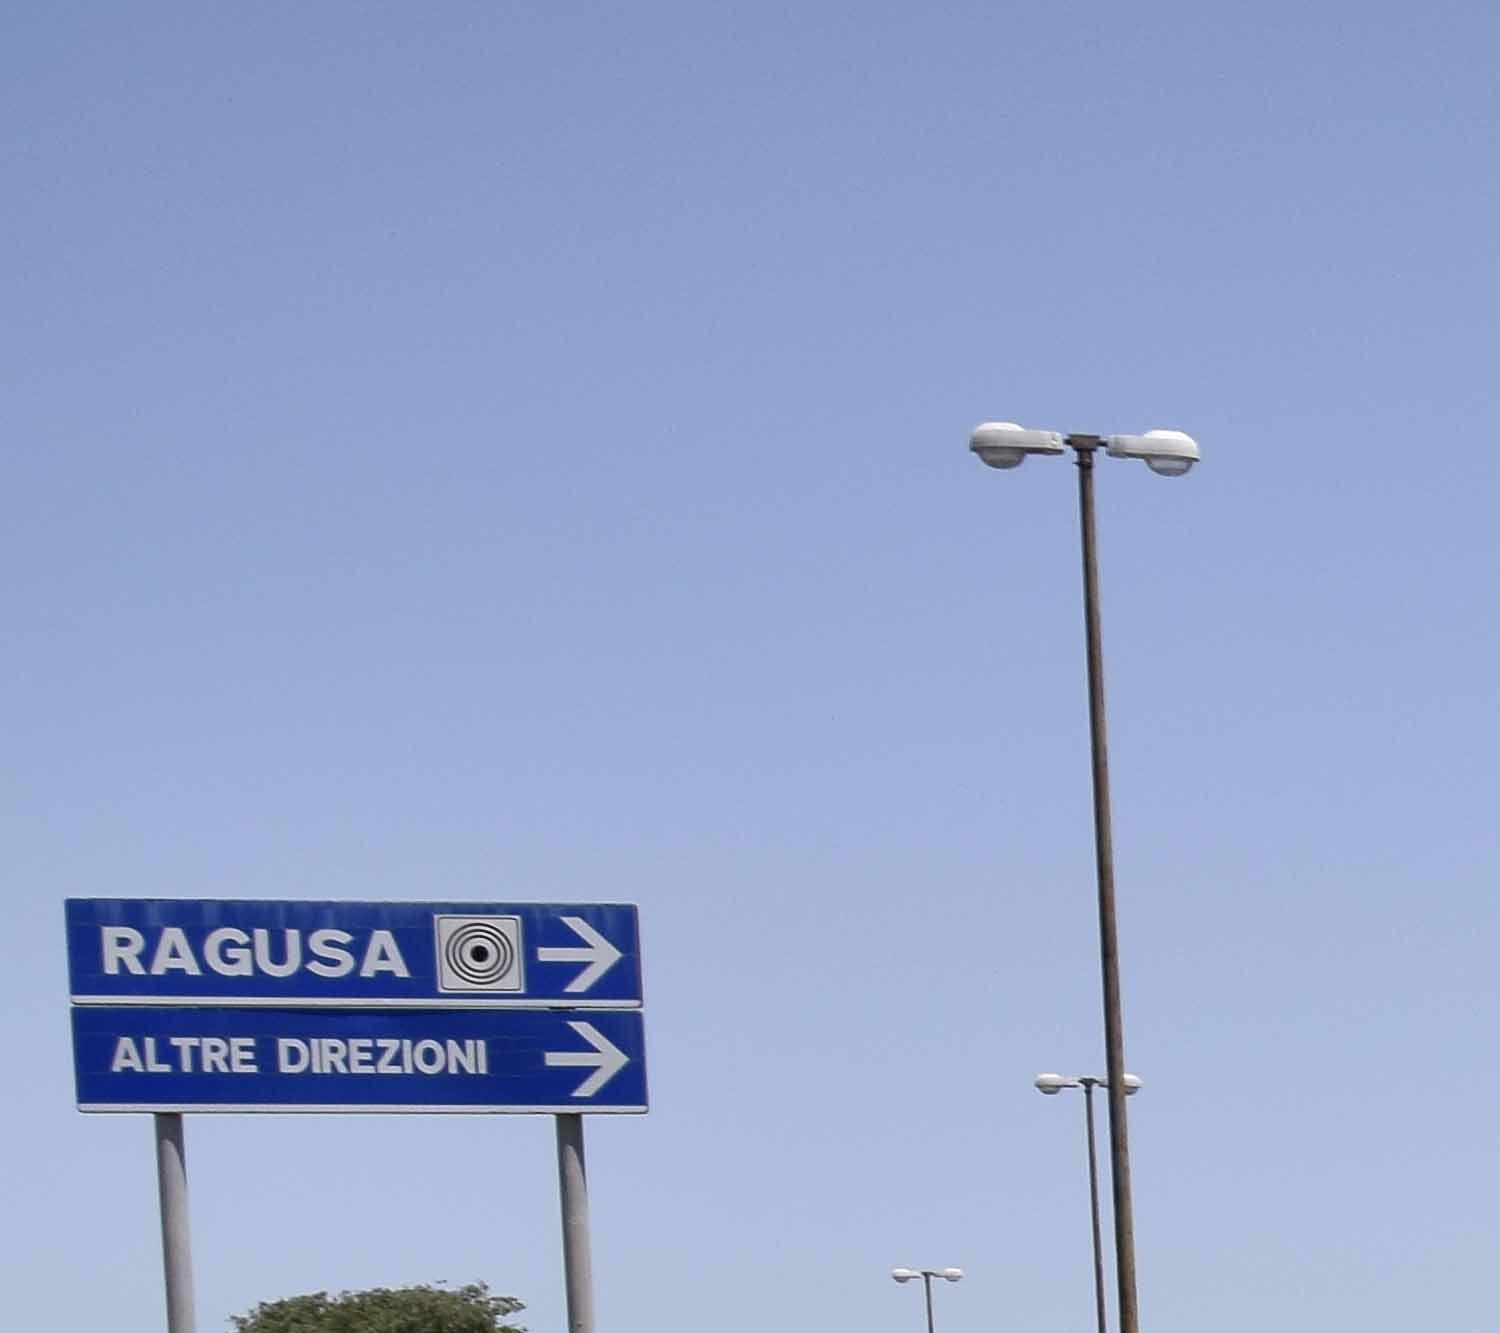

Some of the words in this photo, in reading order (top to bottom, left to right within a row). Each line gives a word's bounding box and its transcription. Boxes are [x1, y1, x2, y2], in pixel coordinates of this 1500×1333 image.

[102, 927, 410, 978] RAGUSA
[111, 1037, 258, 1073] ALTRE
[278, 1040, 487, 1075] DIREZIONI
